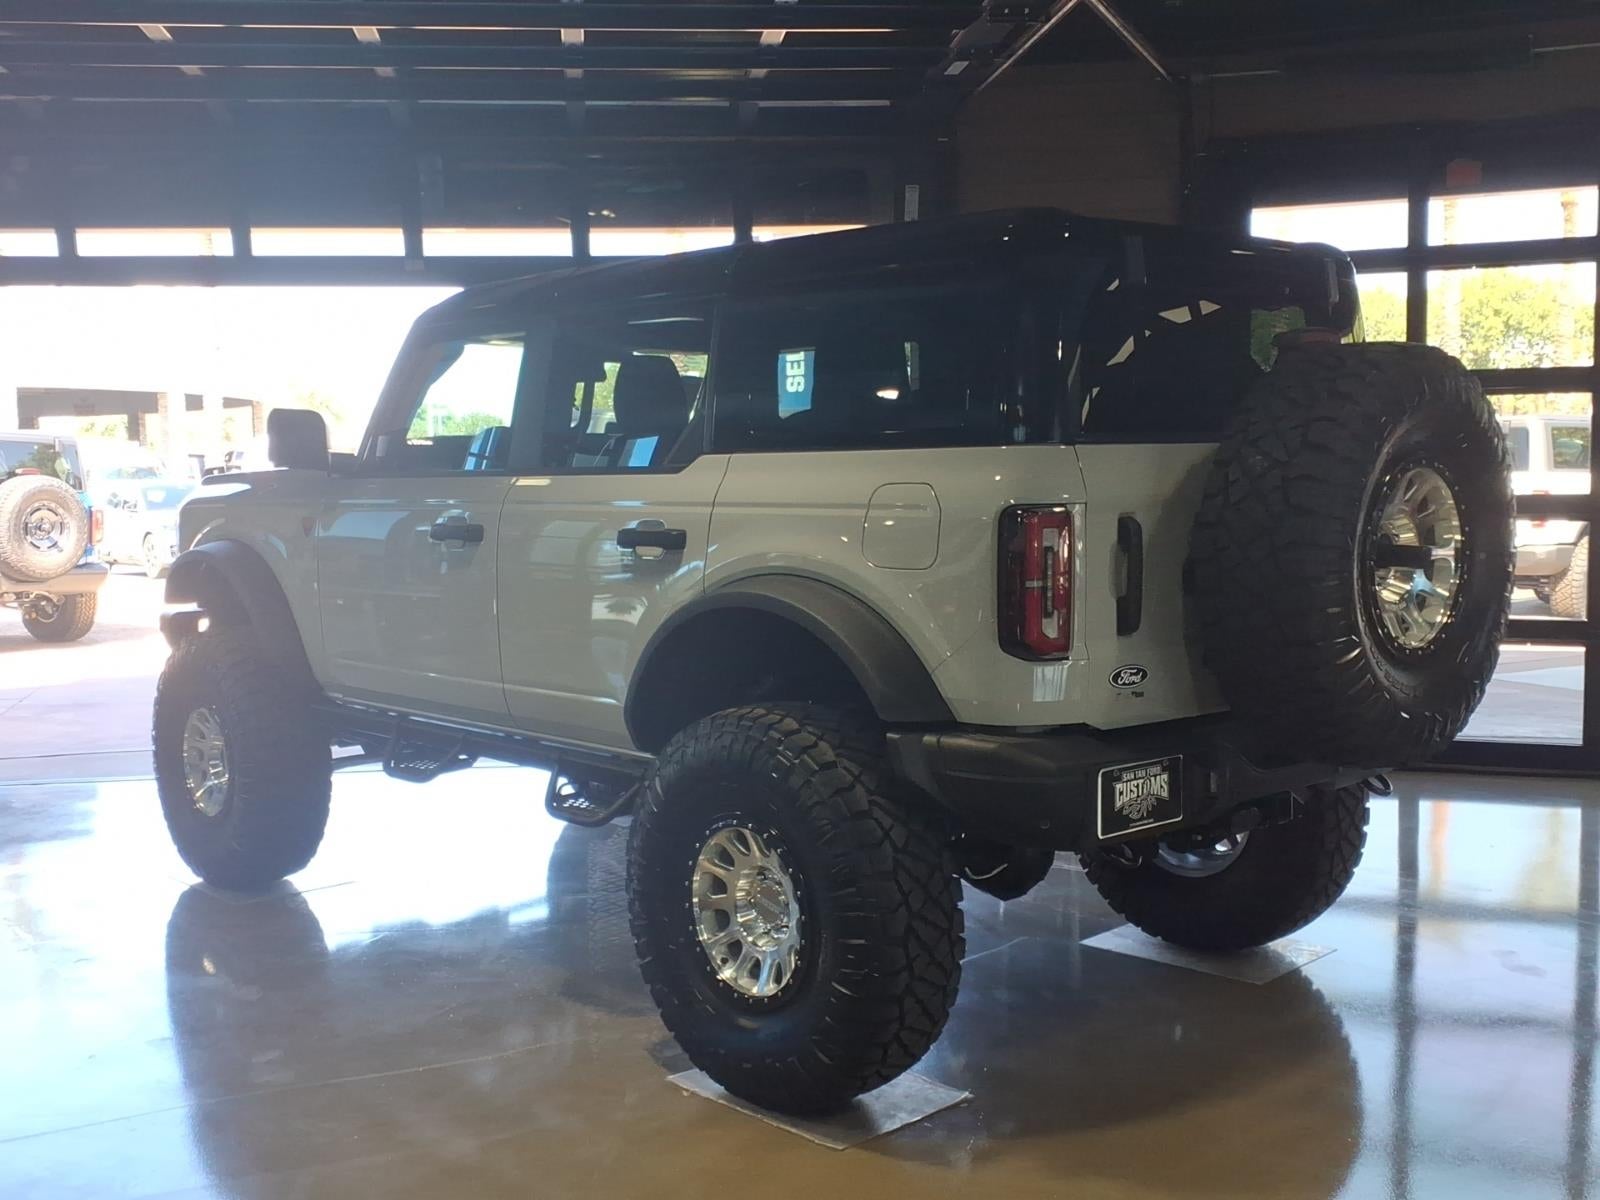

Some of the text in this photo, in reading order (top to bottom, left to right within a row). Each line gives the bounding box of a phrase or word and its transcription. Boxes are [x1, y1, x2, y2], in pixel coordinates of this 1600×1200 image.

[1117, 668, 1143, 685] Ford
[1123, 772, 1135, 781] SAN
[1135, 769, 1146, 779] TAN
[1115, 774, 1168, 808] CUSTOMS
